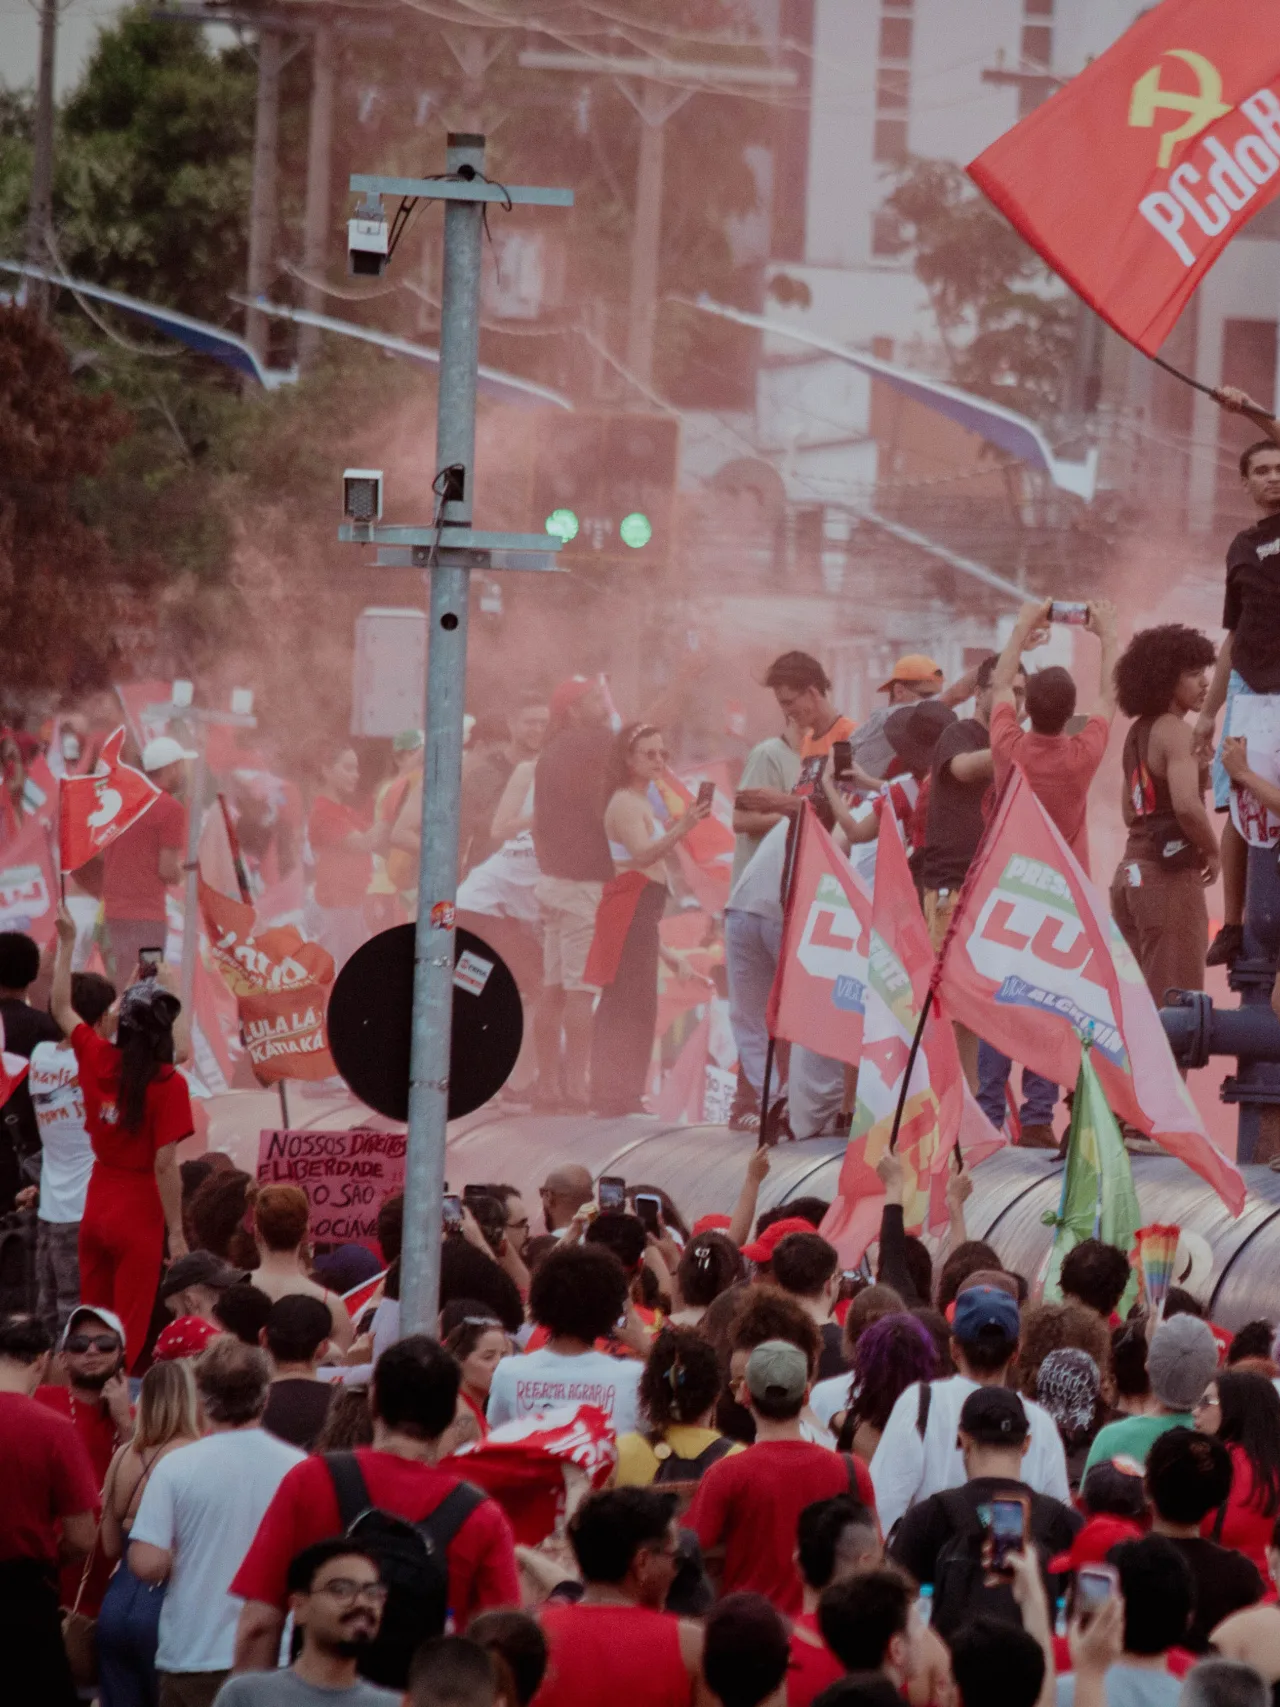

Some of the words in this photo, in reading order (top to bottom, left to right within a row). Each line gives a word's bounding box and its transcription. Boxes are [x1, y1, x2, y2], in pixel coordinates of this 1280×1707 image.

[266, 1131, 347, 1161] NOSSOS
[272, 1157, 385, 1182] LIBERDADE
[329, 1179, 375, 1208] SÃO
[311, 1212, 380, 1239] OCIÁVE
